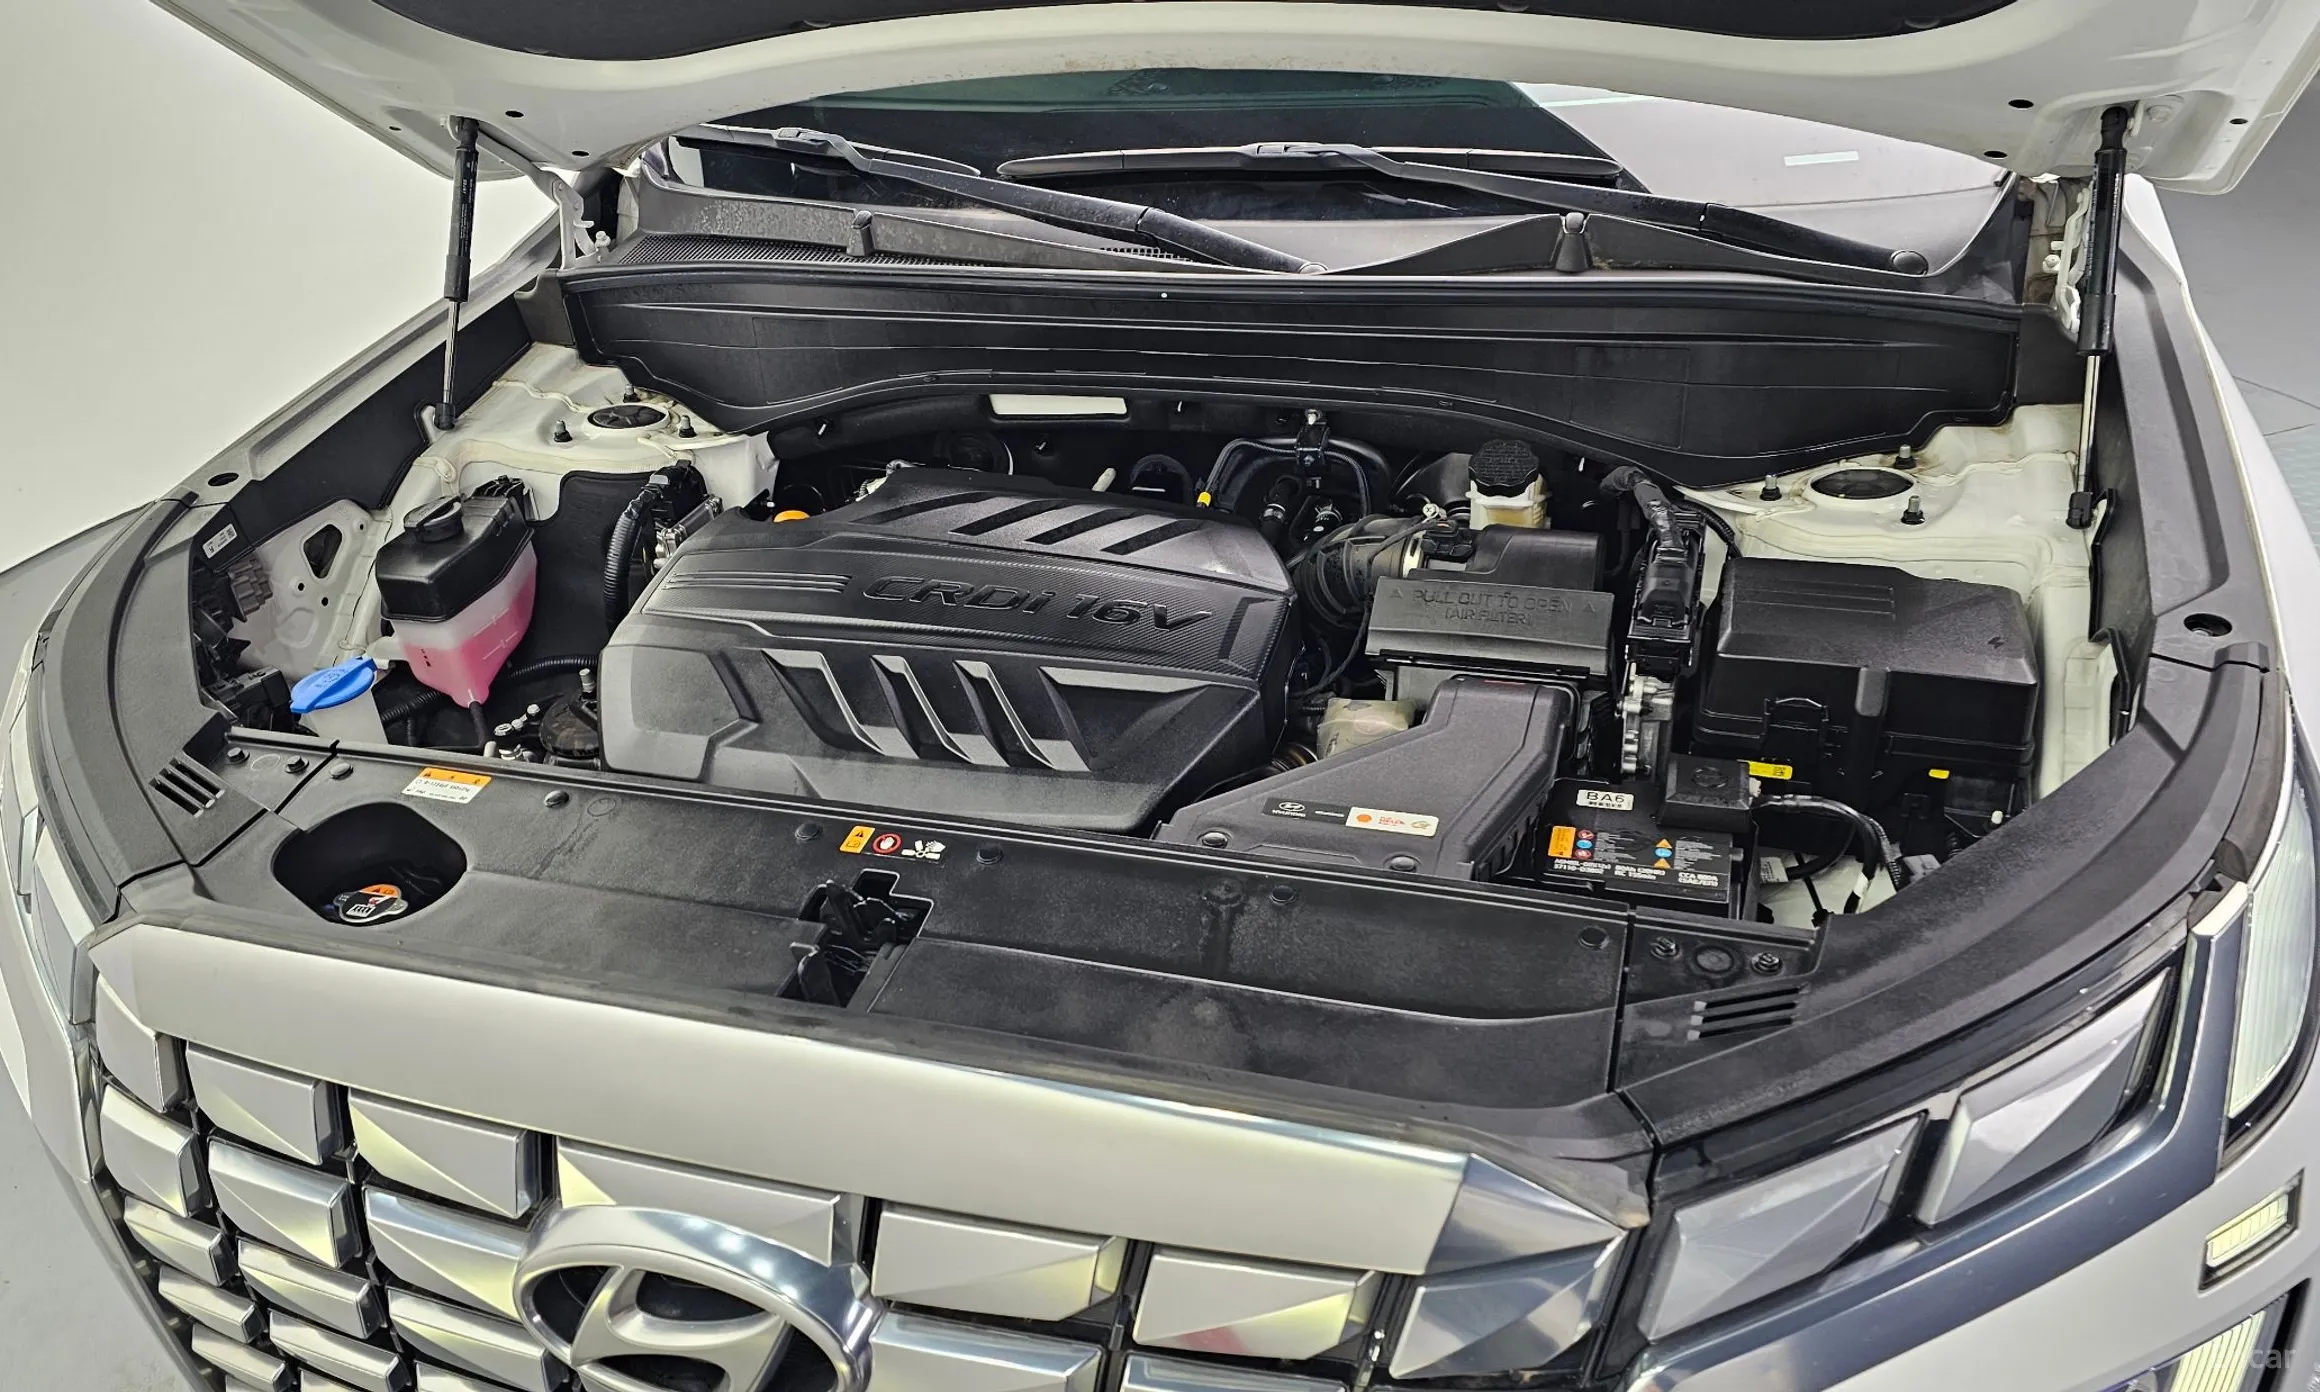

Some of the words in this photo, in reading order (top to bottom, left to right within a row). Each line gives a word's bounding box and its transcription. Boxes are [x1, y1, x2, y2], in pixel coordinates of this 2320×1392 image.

[862, 575, 1057, 614] CRDi
[1065, 593, 1213, 631] 16V
[1411, 589, 1454, 605] PULL
[1457, 592, 1493, 608] OUT
[1498, 591, 1520, 609] TO
[1523, 597, 1573, 613] OPEN
[1586, 791, 1626, 804] BA6
